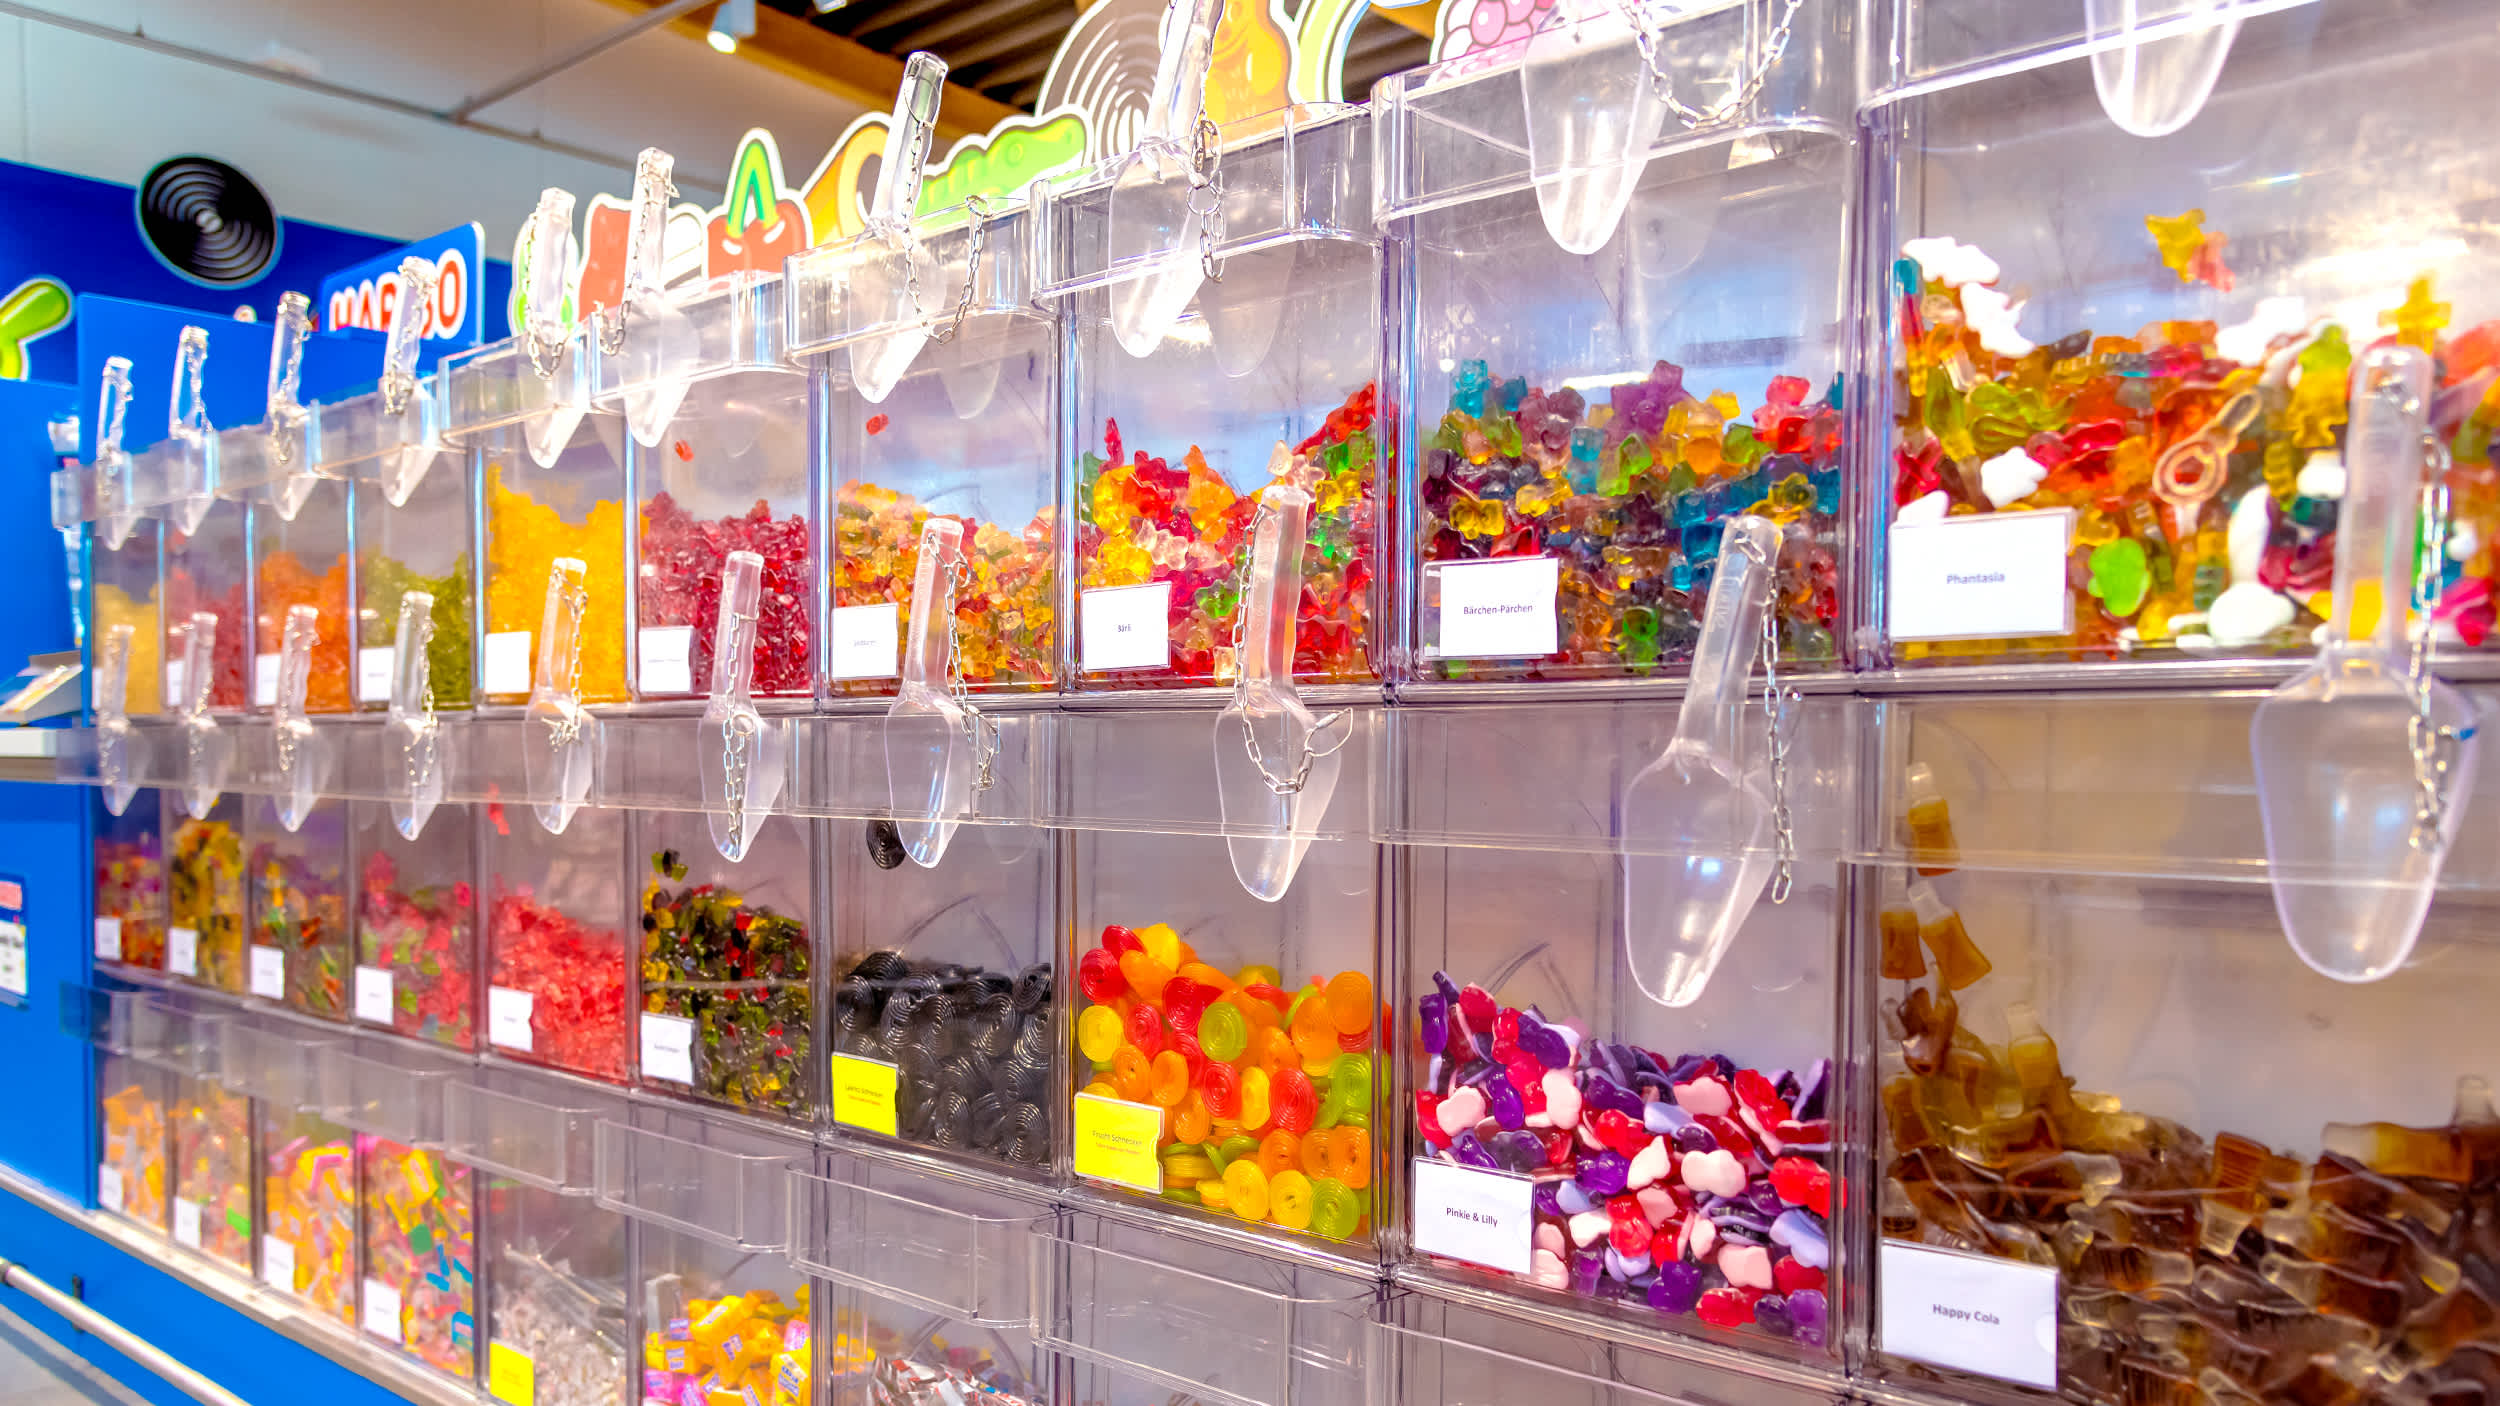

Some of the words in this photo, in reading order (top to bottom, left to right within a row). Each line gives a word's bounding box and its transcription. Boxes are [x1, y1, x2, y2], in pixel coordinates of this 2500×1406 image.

[1946, 572, 2006, 585] Phantasia
[1446, 1207, 1471, 1220] Pinkie
[1472, 1212, 1479, 1222] &
[1481, 1213, 1498, 1228] Lilly
[1932, 1303, 1971, 1322] Happy
[1974, 1311, 2000, 1325] Cola
